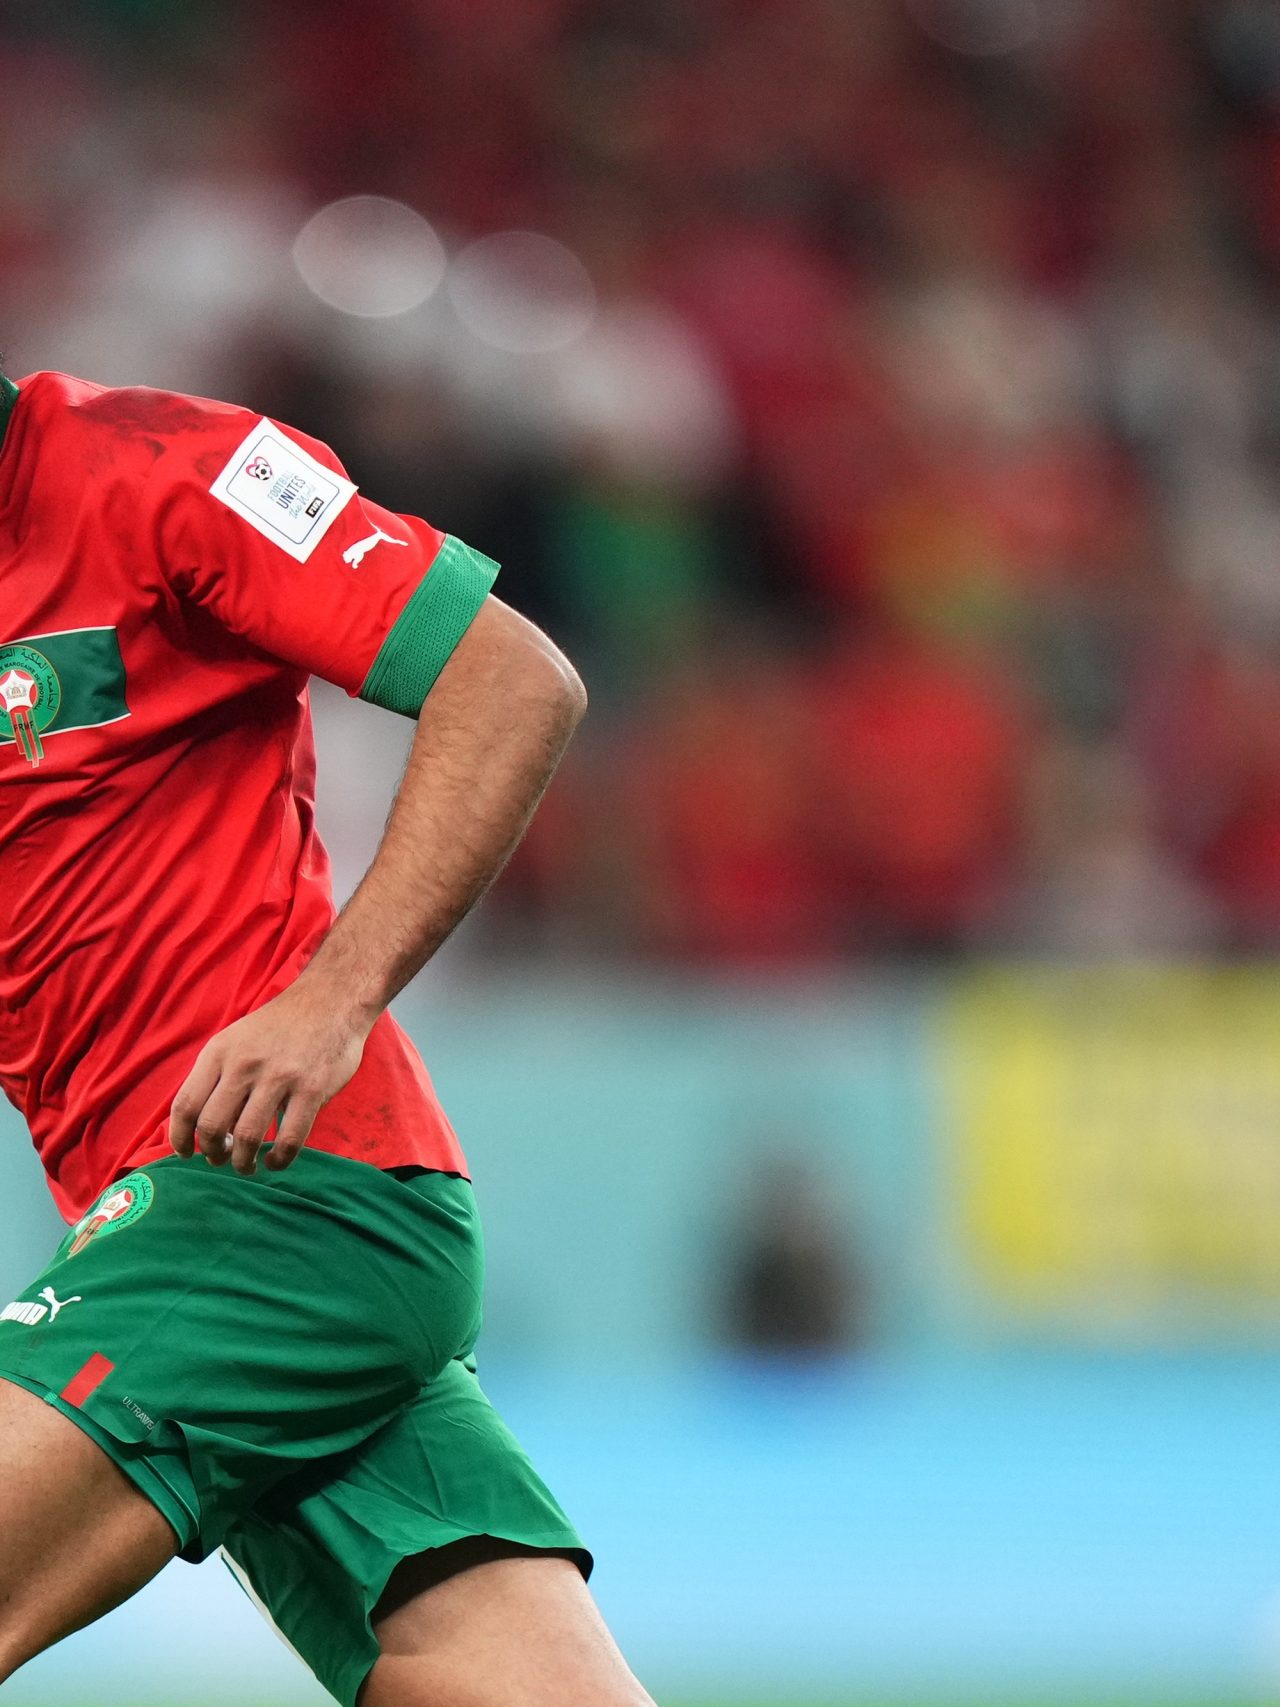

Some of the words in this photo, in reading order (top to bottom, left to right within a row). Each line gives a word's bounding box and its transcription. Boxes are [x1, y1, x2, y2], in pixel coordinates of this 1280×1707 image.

[267, 471, 295, 502] FOOTBA
[276, 475, 306, 509] UNITES
[306, 499, 322, 516] FIFA
[122, 1396, 155, 1431] ULTRAWE
